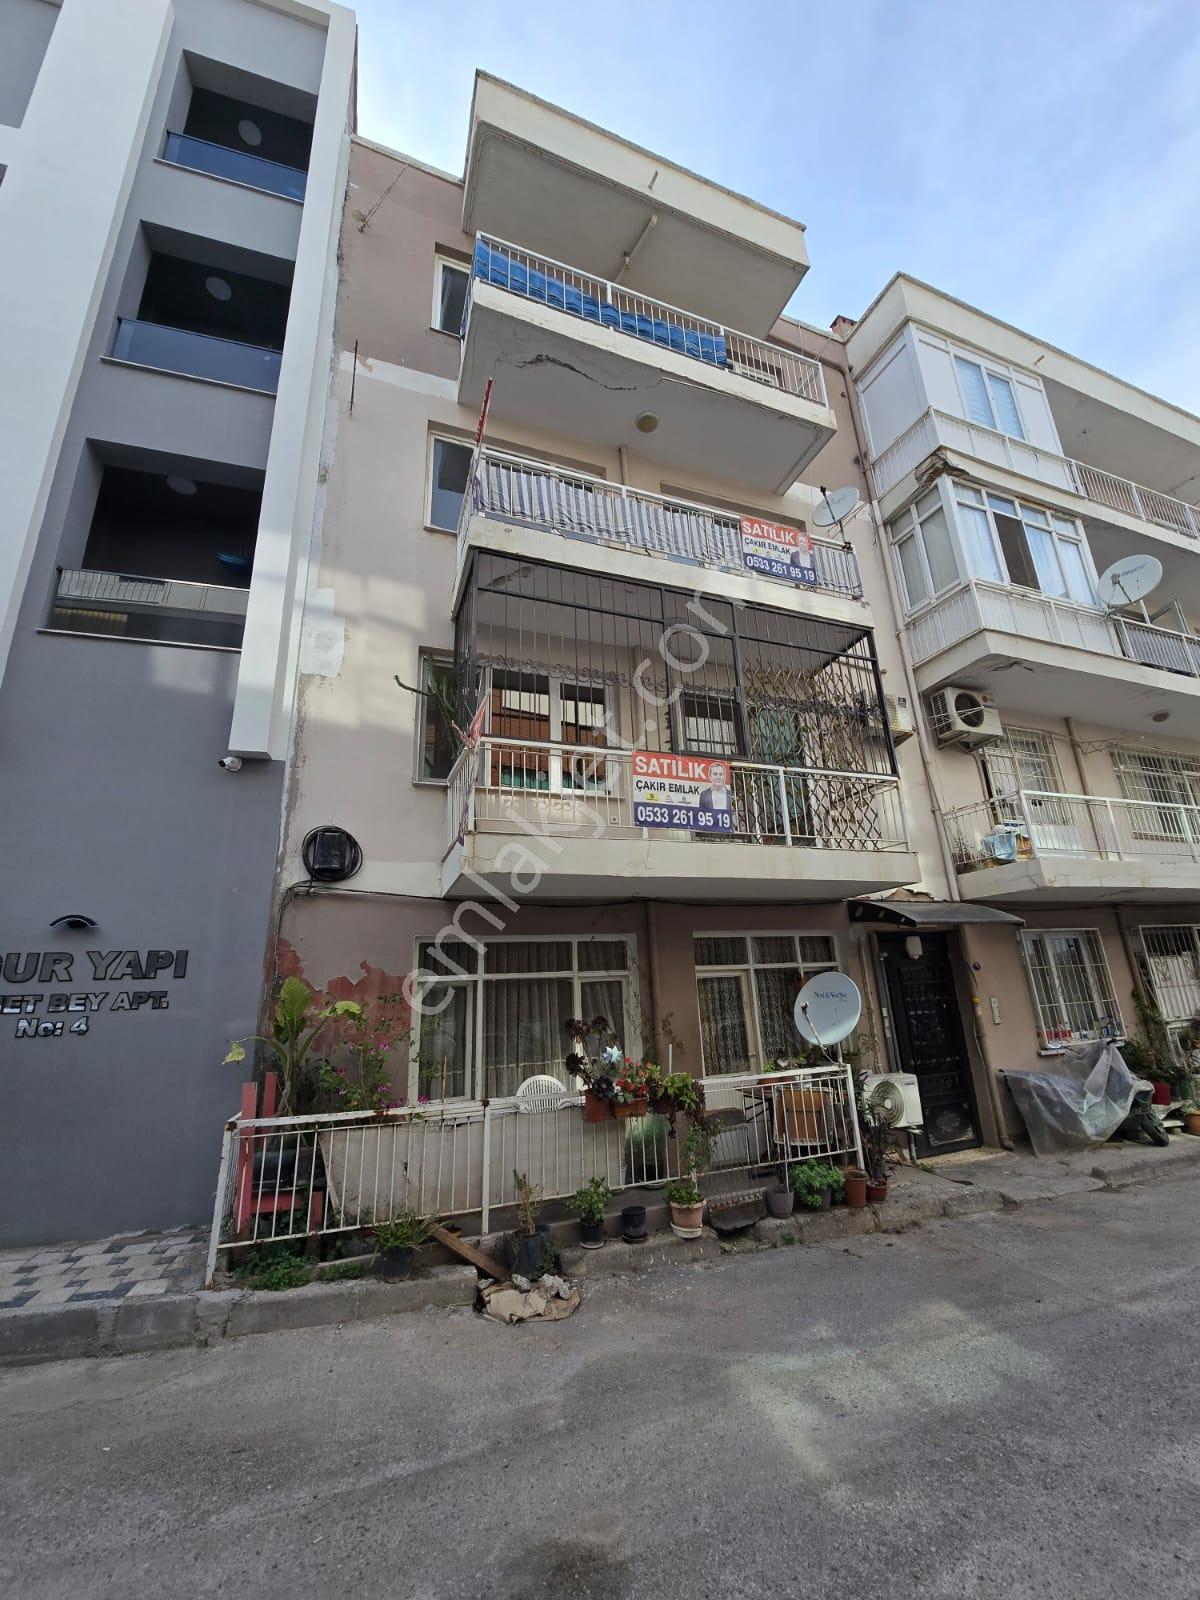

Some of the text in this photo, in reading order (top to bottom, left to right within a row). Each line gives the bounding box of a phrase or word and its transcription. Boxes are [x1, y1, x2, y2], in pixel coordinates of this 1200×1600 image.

[742, 521, 795, 544] SATILIK
[744, 537, 766, 548] ÇAKIR
[768, 543, 790, 554] EMLAK
[746, 555, 815, 581] 0533 261 95 19
[635, 756, 707, 778] SATILIK
[636, 780, 700, 795] ÇAKIR EMLAK
[637, 805, 731, 828] 0533 261 95 19
[0, 950, 189, 983] UR YAPI
[0, 990, 169, 1014] ET BEY APT.
[69, 1016, 90, 1036] 4
